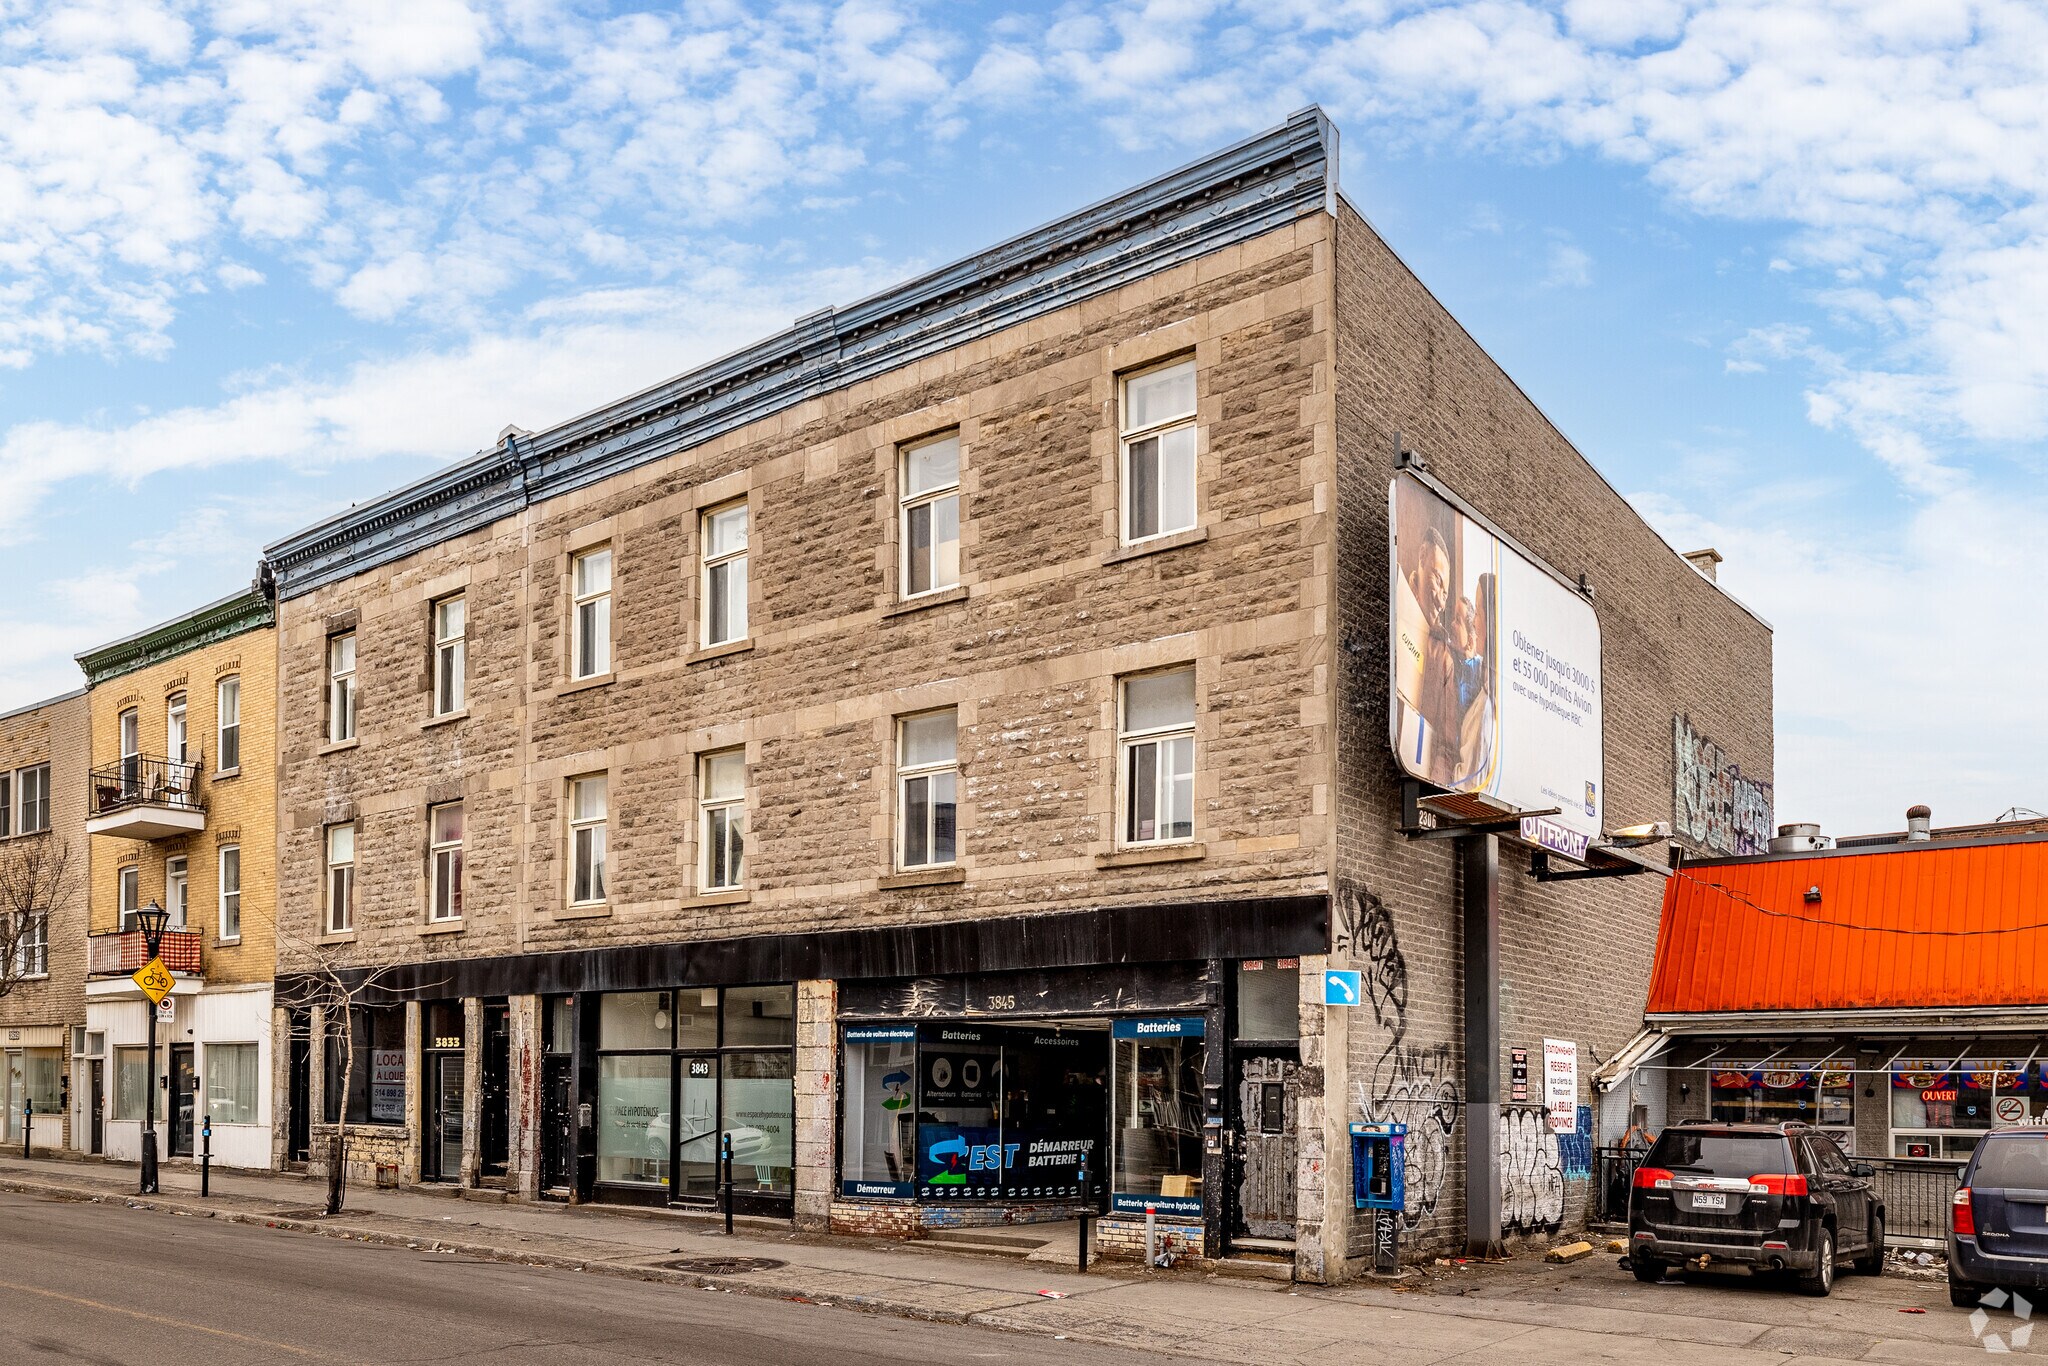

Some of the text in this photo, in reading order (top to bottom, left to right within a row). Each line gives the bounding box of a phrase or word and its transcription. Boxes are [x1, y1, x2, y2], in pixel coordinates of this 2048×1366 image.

[1512, 629, 1596, 695] Obtenez jusqu'à 3000 $
[1512, 657, 1592, 714] et 55 000 points Avion
[1512, 681, 1527, 697] avec
[1527, 689, 1538, 703] une
[1418, 810, 1437, 829] 2306
[1523, 816, 1584, 857] OUTFRONT
[988, 995, 1016, 1010] 3845
[1136, 1021, 1181, 1034] Batteries
[846, 1029, 914, 1039] Batterie de voiture électrique
[941, 1030, 981, 1041] Batteries
[435, 1037, 460, 1048] 3833
[1034, 1035, 1079, 1047] Accessoires
[1545, 1044, 1575, 1056] STATIONNEMENT
[691, 1062, 709, 1074] 3843
[1557, 1077, 1567, 1085] clients
[374, 1088, 385, 1097] 514
[926, 1090, 957, 1098] Alternateurs
[960, 1090, 982, 1098] Batteries
[1552, 1086, 1571, 1096] Restaurant
[1921, 1090, 1957, 1101] OUVERT
[374, 1103, 385, 1112] 514
[627, 1104, 659, 1117] HYPOTÉNUSE
[1550, 1101, 1572, 1113] LA BELLE
[1548, 1117, 1573, 1129] PROVINCE
[1029, 1138, 1094, 1154] DÉMARREUR
[1028, 1153, 1078, 1168] BATTERIE
[856, 1183, 896, 1195] Démarreur
[1117, 1198, 1142, 1208] Batterie
[1175, 1202, 1200, 1211] hybride
[1693, 1195, 1725, 1206] N59 YSA
